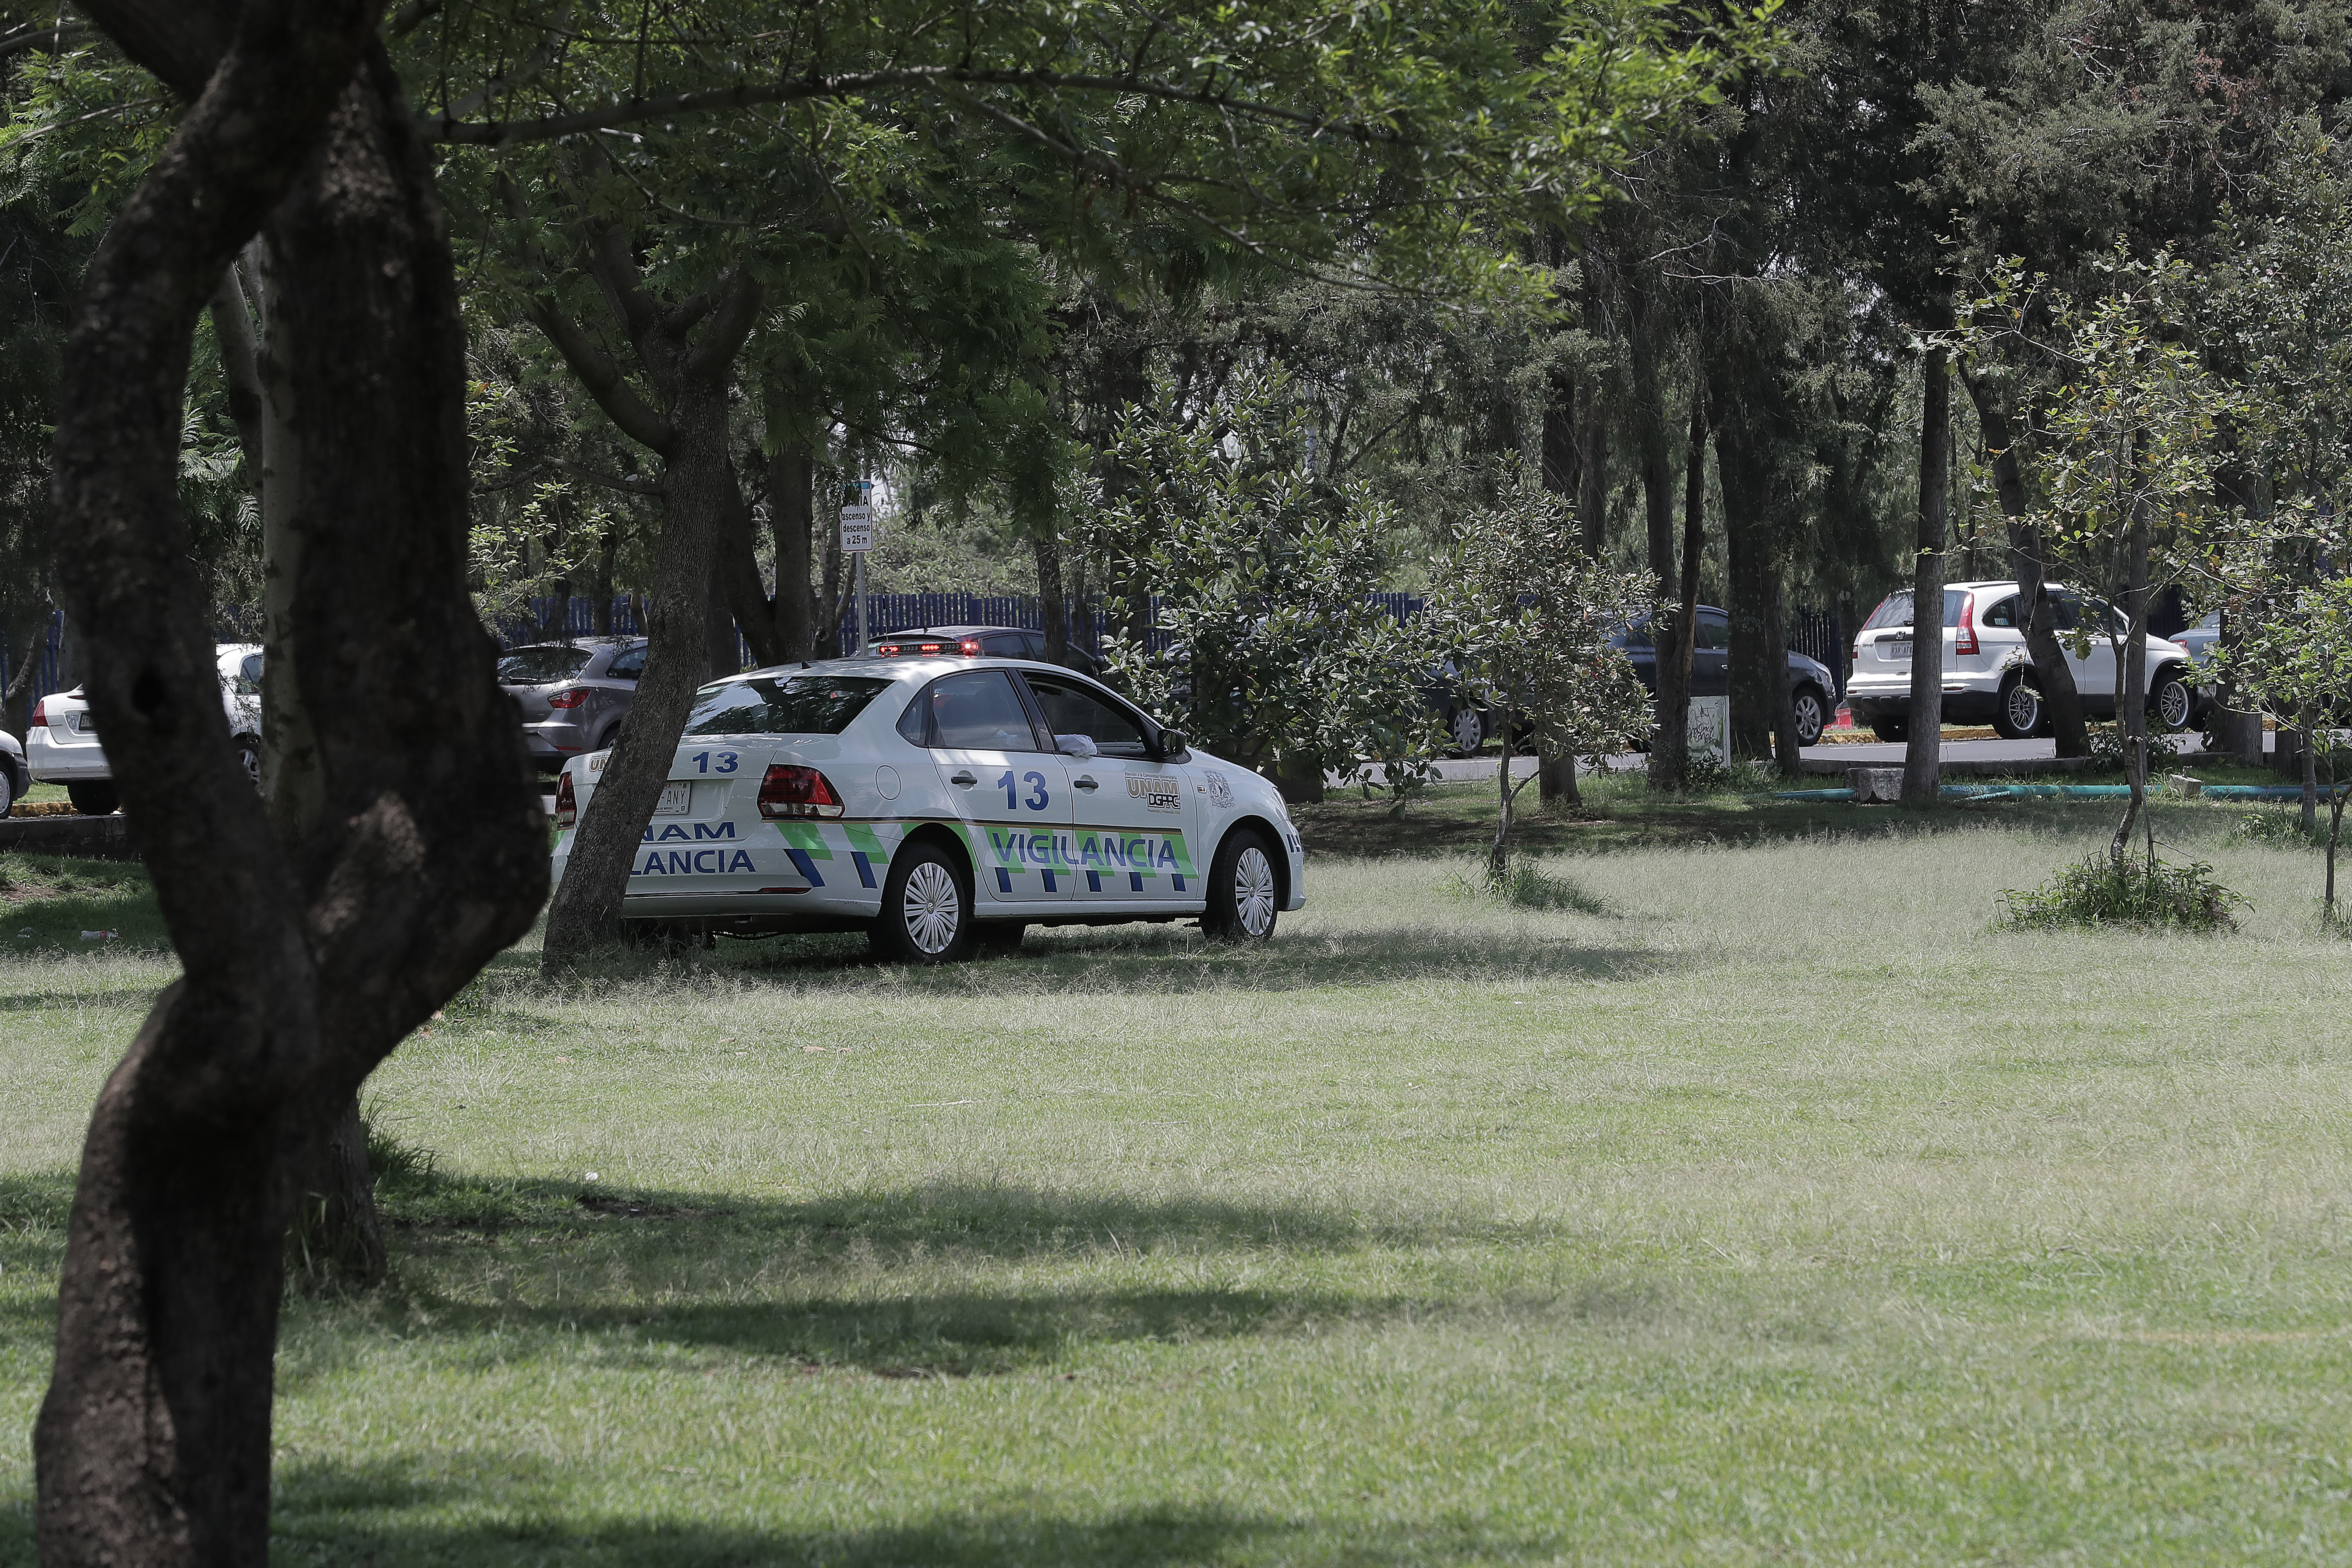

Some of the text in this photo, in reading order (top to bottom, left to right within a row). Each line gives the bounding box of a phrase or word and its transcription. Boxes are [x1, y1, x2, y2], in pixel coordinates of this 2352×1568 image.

[867, 512, 870, 521] y
[843, 524, 870, 532] descenso
[852, 535, 861, 544] 25
[692, 752, 738, 773] 13
[997, 770, 1049, 811] 13
[1126, 778, 1180, 798] UNAM
[992, 833, 1180, 869] VIGILANCIA
